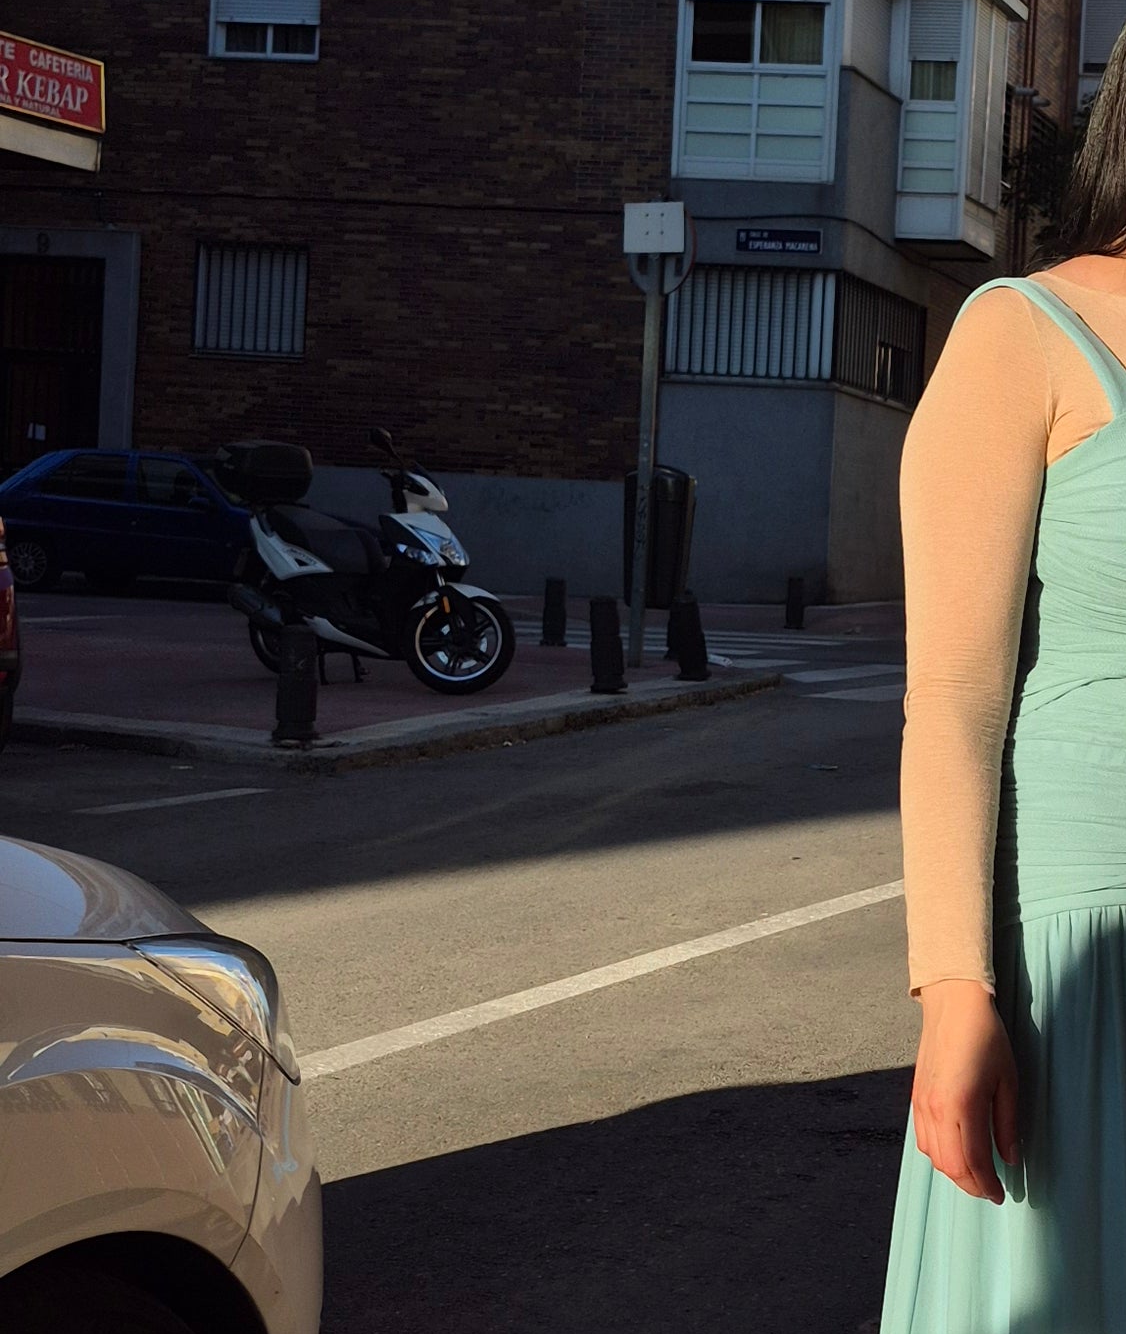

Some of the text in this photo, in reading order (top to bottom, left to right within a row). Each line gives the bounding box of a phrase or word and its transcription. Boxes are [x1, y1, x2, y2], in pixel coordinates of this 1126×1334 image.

[29, 48, 94, 83] CAFETERIA
[16, 69, 89, 113] KEBAP
[21, 100, 61, 118] NATURAL
[748, 240, 818, 251] ESPERANZA MACARENA
